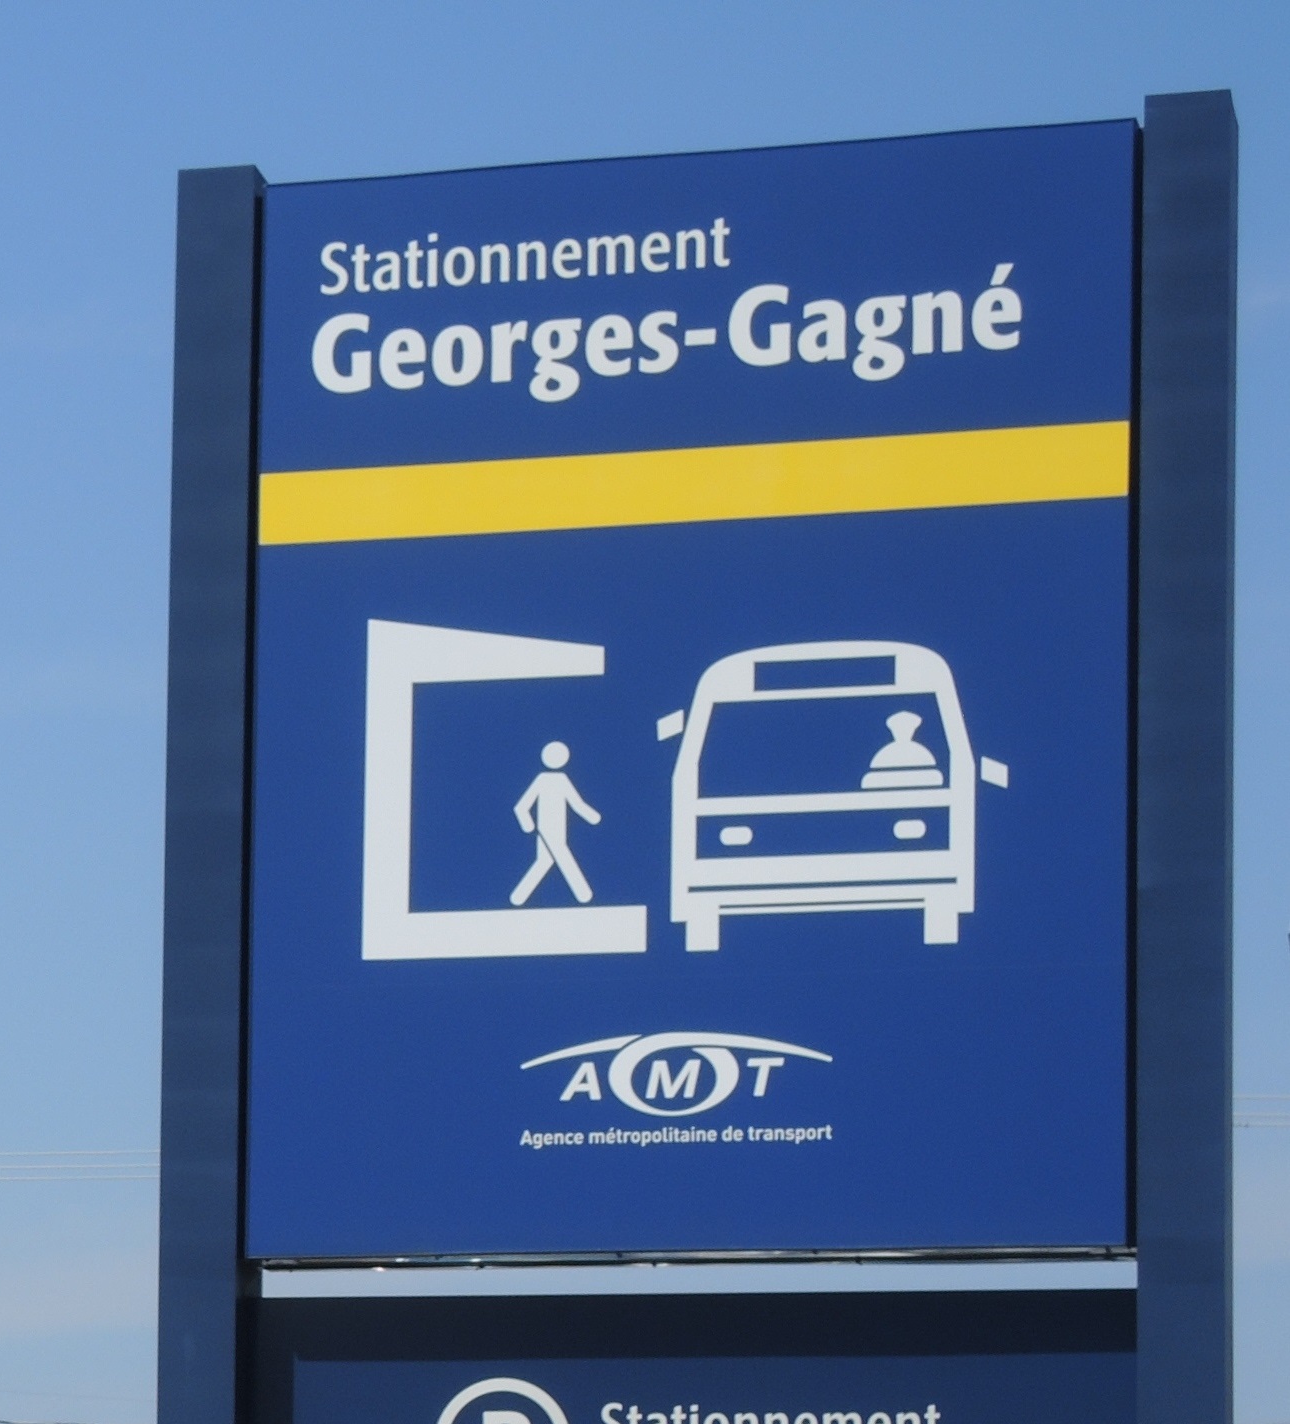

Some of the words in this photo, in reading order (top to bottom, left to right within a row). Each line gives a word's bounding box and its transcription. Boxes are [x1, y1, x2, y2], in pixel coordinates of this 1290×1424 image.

[319, 216, 731, 297] Stationnement
[310, 262, 1023, 403] Georges-Gagné
[558, 1055, 786, 1110] AMT
[519, 1129, 584, 1150] Agence
[587, 1126, 719, 1148] métropolitaine
[720, 1124, 744, 1143] de
[747, 1123, 834, 1145] transport
